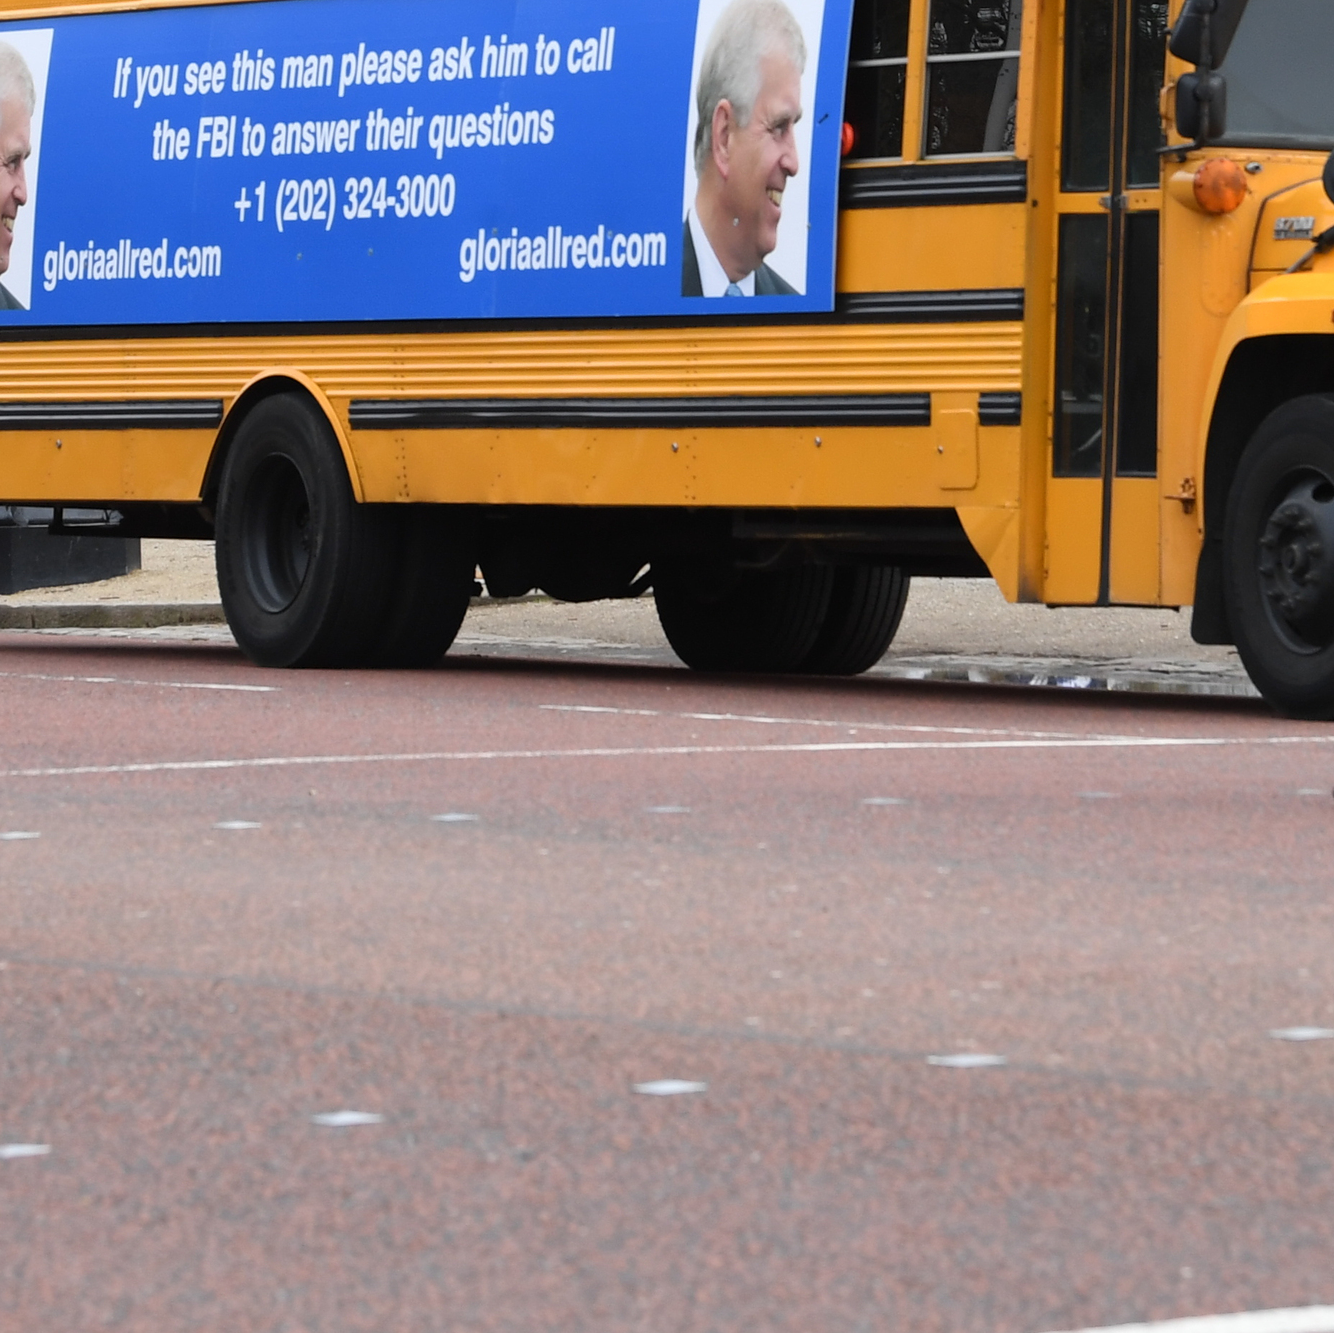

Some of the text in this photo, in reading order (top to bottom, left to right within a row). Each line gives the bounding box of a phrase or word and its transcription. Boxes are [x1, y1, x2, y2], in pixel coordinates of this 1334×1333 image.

[113, 26, 616, 109] If you see this man please ask him to call
[152, 104, 555, 161] the FBI to answer their questions
[234, 173, 456, 233] +1 (202) 324-3000
[43, 237, 222, 292] gloriaallred.com
[459, 224, 667, 283] gloriaallred.com
